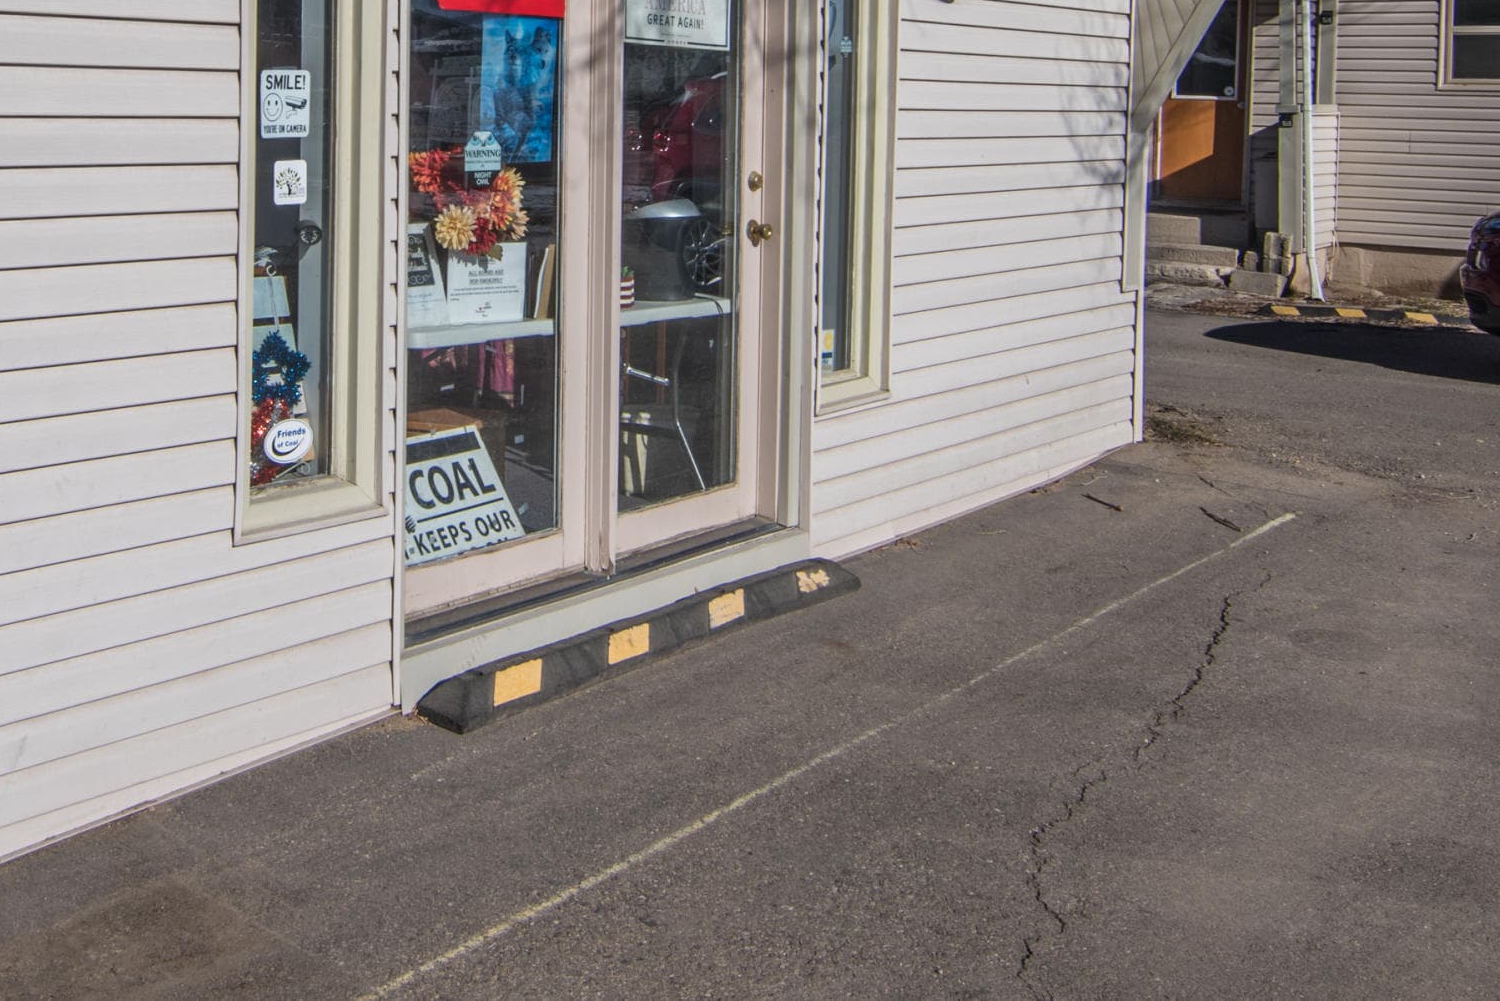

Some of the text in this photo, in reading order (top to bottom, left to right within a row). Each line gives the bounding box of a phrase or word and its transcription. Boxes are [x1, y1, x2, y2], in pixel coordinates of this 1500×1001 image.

[647, 13, 704, 30] GREAT AGAIN!
[265, 74, 306, 90] SMILE!
[286, 124, 307, 133] CAMERA
[465, 150, 501, 158] WARNING
[474, 171, 492, 179] NIGHT
[277, 427, 306, 438] Friends
[409, 458, 496, 509] COAL
[413, 521, 473, 556] KEEPS
[475, 509, 516, 537] OUR
